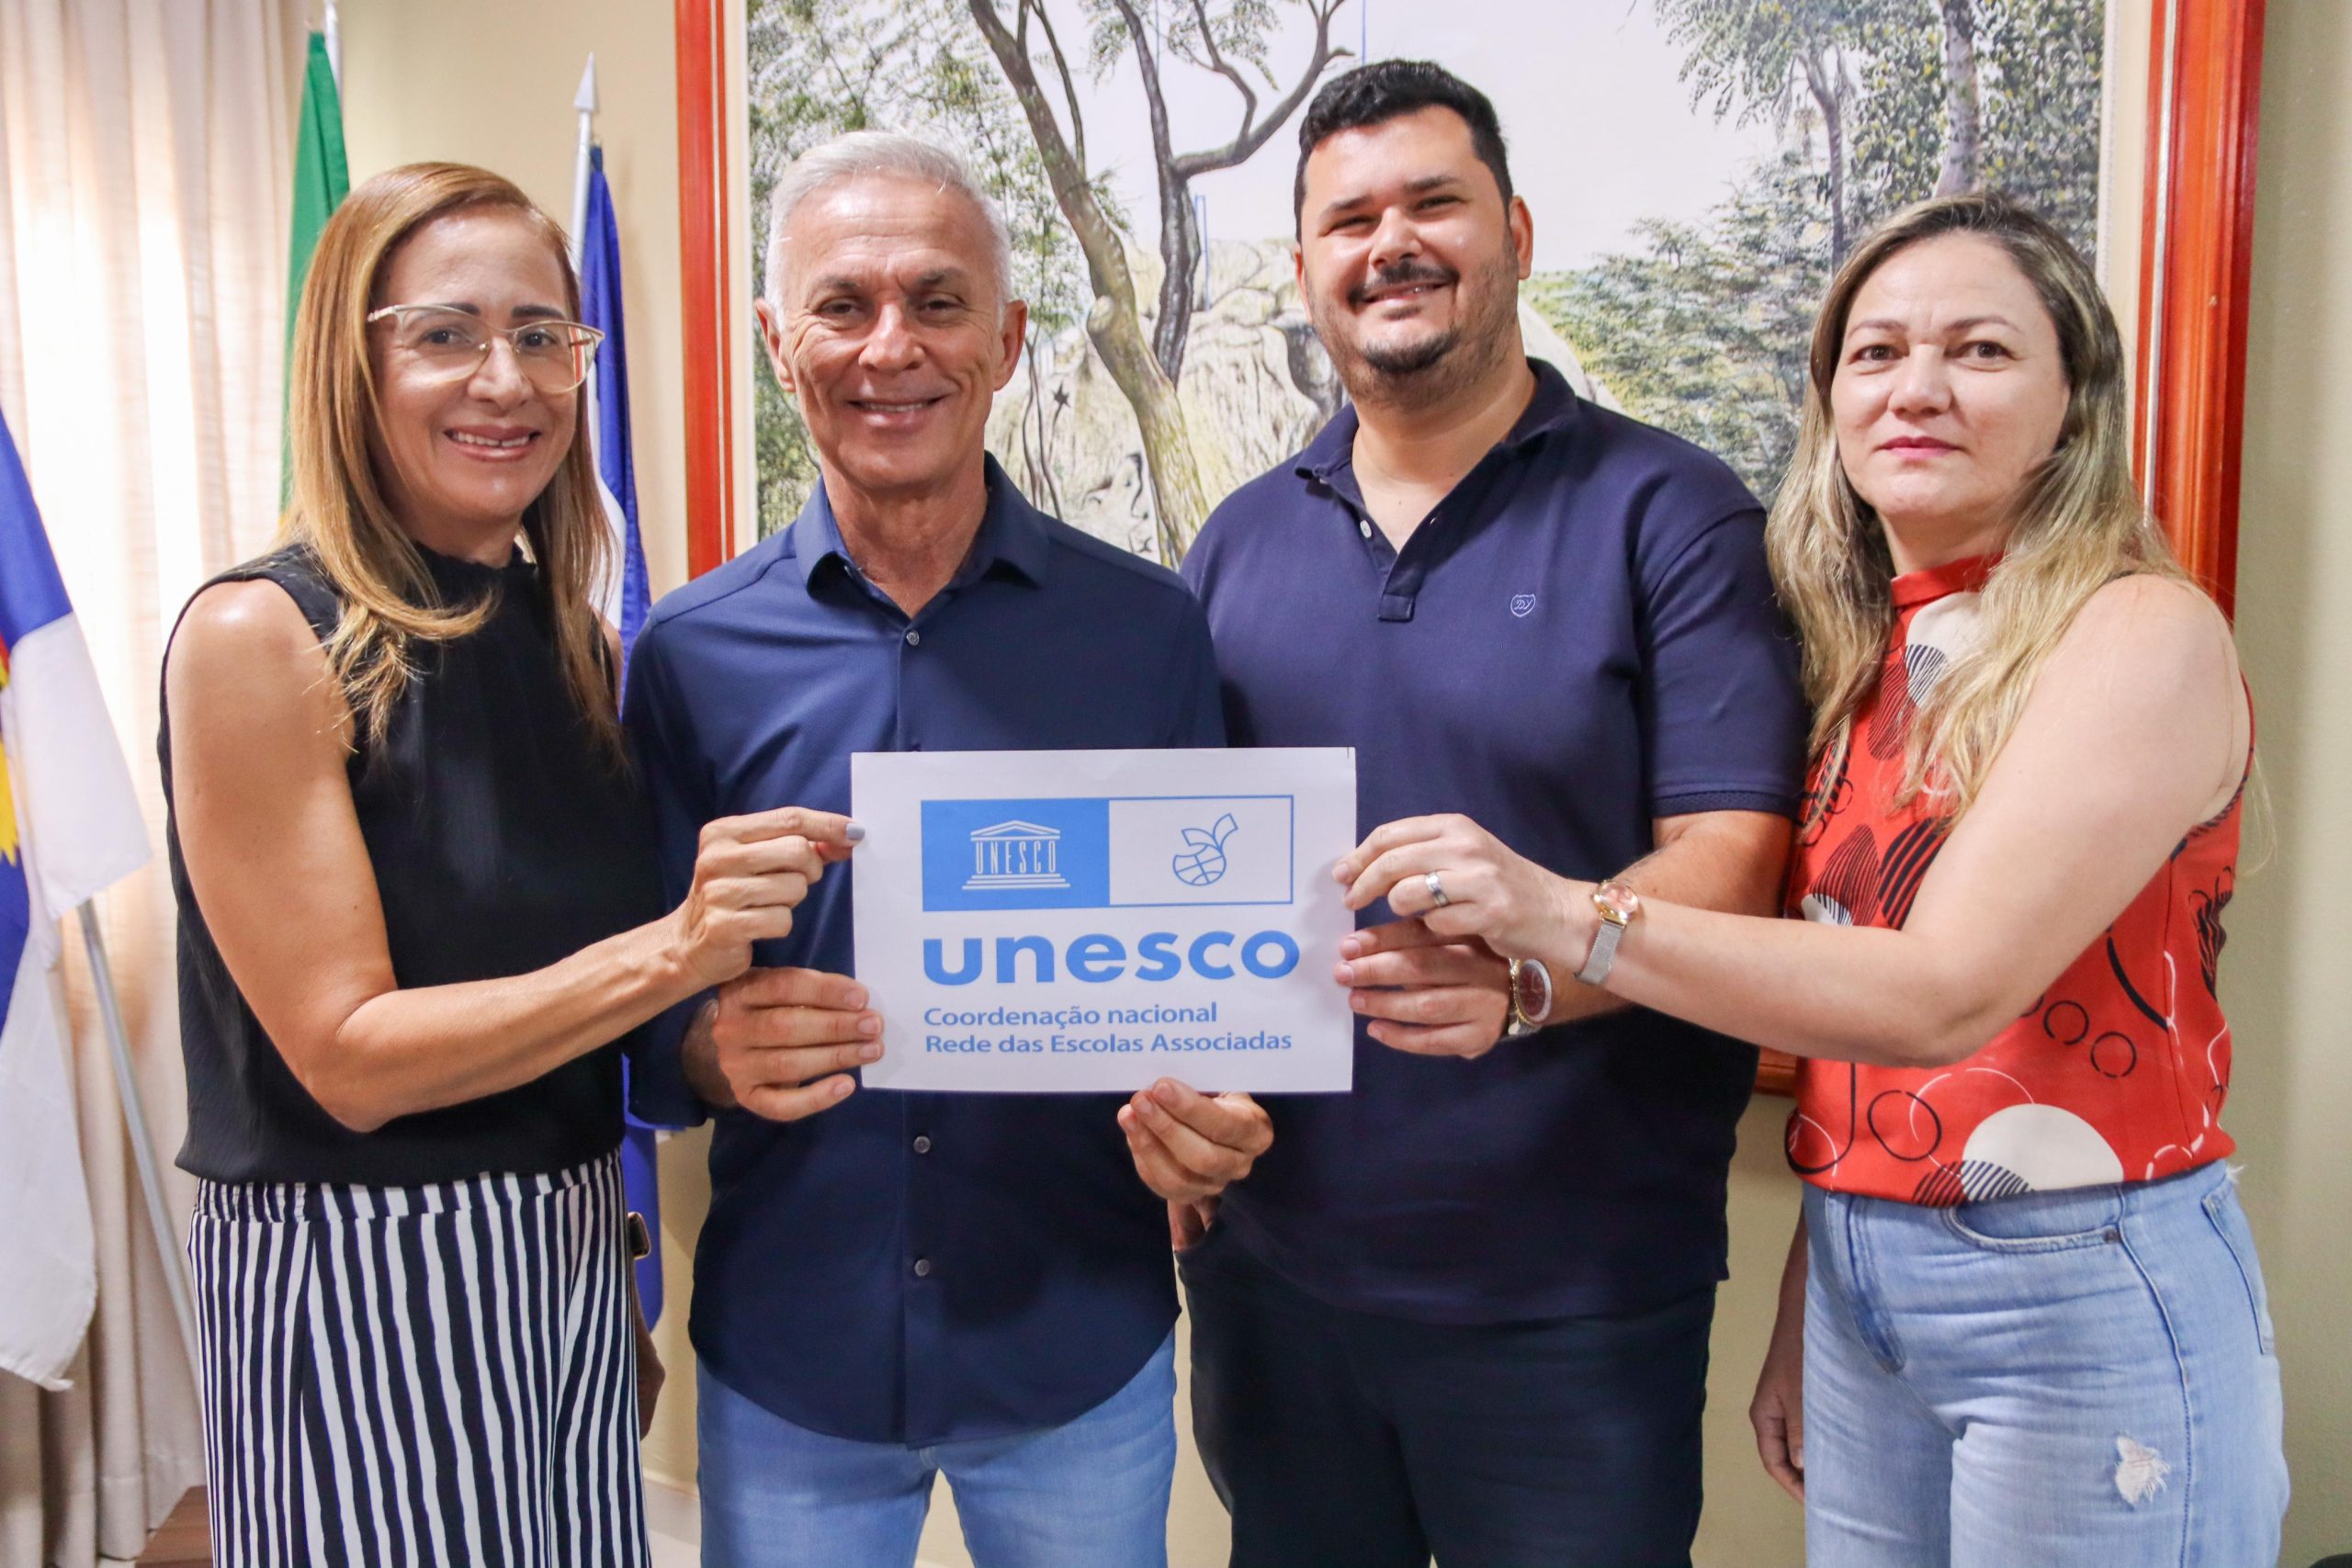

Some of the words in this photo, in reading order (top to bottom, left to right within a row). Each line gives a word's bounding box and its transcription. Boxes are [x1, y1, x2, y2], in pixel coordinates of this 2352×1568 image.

[976, 840, 1056, 874] UNESCO
[922, 930, 1301, 986] unesco
[924, 1005, 1101, 1027] Coordenação
[1108, 1001, 1217, 1023] nacional
[926, 1034, 991, 1053] Rede
[999, 1034, 1044, 1053] das
[1050, 1033, 1143, 1053] Escolas
[1150, 1031, 1292, 1052] Associadas
